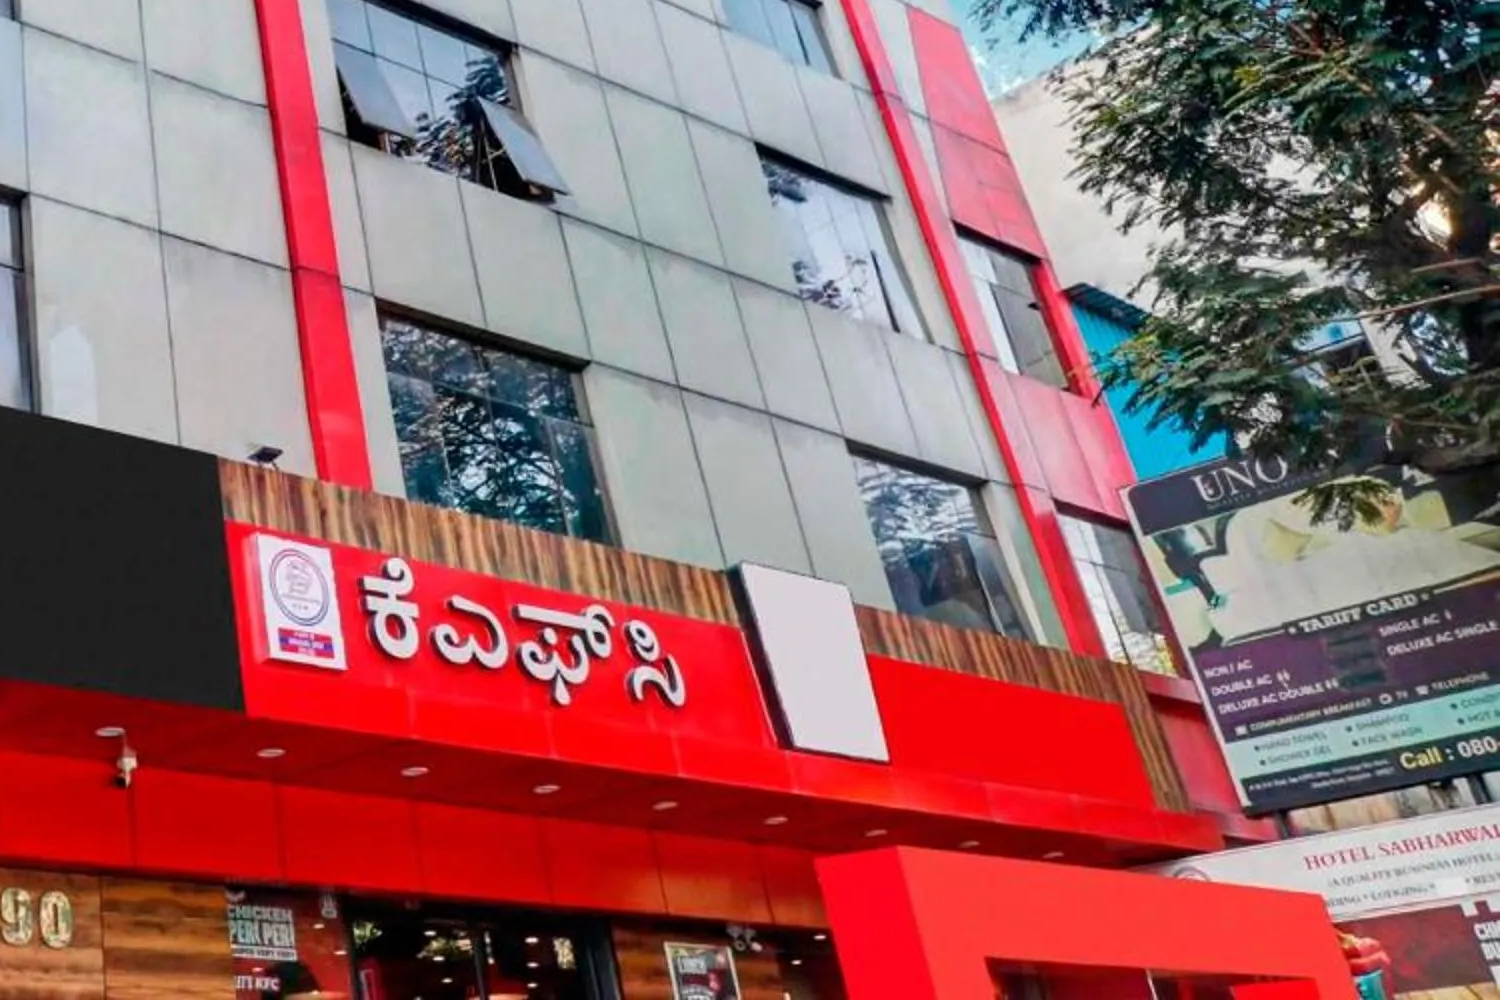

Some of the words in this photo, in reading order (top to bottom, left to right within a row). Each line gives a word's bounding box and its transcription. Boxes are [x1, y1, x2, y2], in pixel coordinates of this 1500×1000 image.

[1190, 454, 1288, 502] UNO
[1298, 607, 1361, 633] TARIFF
[1366, 593, 1419, 616] CARD
[1379, 618, 1420, 637] SINGLE
[1422, 613, 1440, 625] AC
[1387, 636, 1435, 656] DELUXE
[1436, 631, 1454, 643] AC
[1454, 620, 1499, 639] SINGLE
[1237, 659, 1253, 671] AC
[1211, 679, 1253, 697] DOUBLE
[1256, 674, 1273, 685] AC
[1218, 697, 1260, 714] DELUXE
[1262, 693, 1278, 704] AC
[1279, 682, 1324, 700] DOUBLE
[1400, 746, 1444, 769] Call
[1304, 846, 1376, 871] HOTEL
[0, 887, 72, 949] 90
